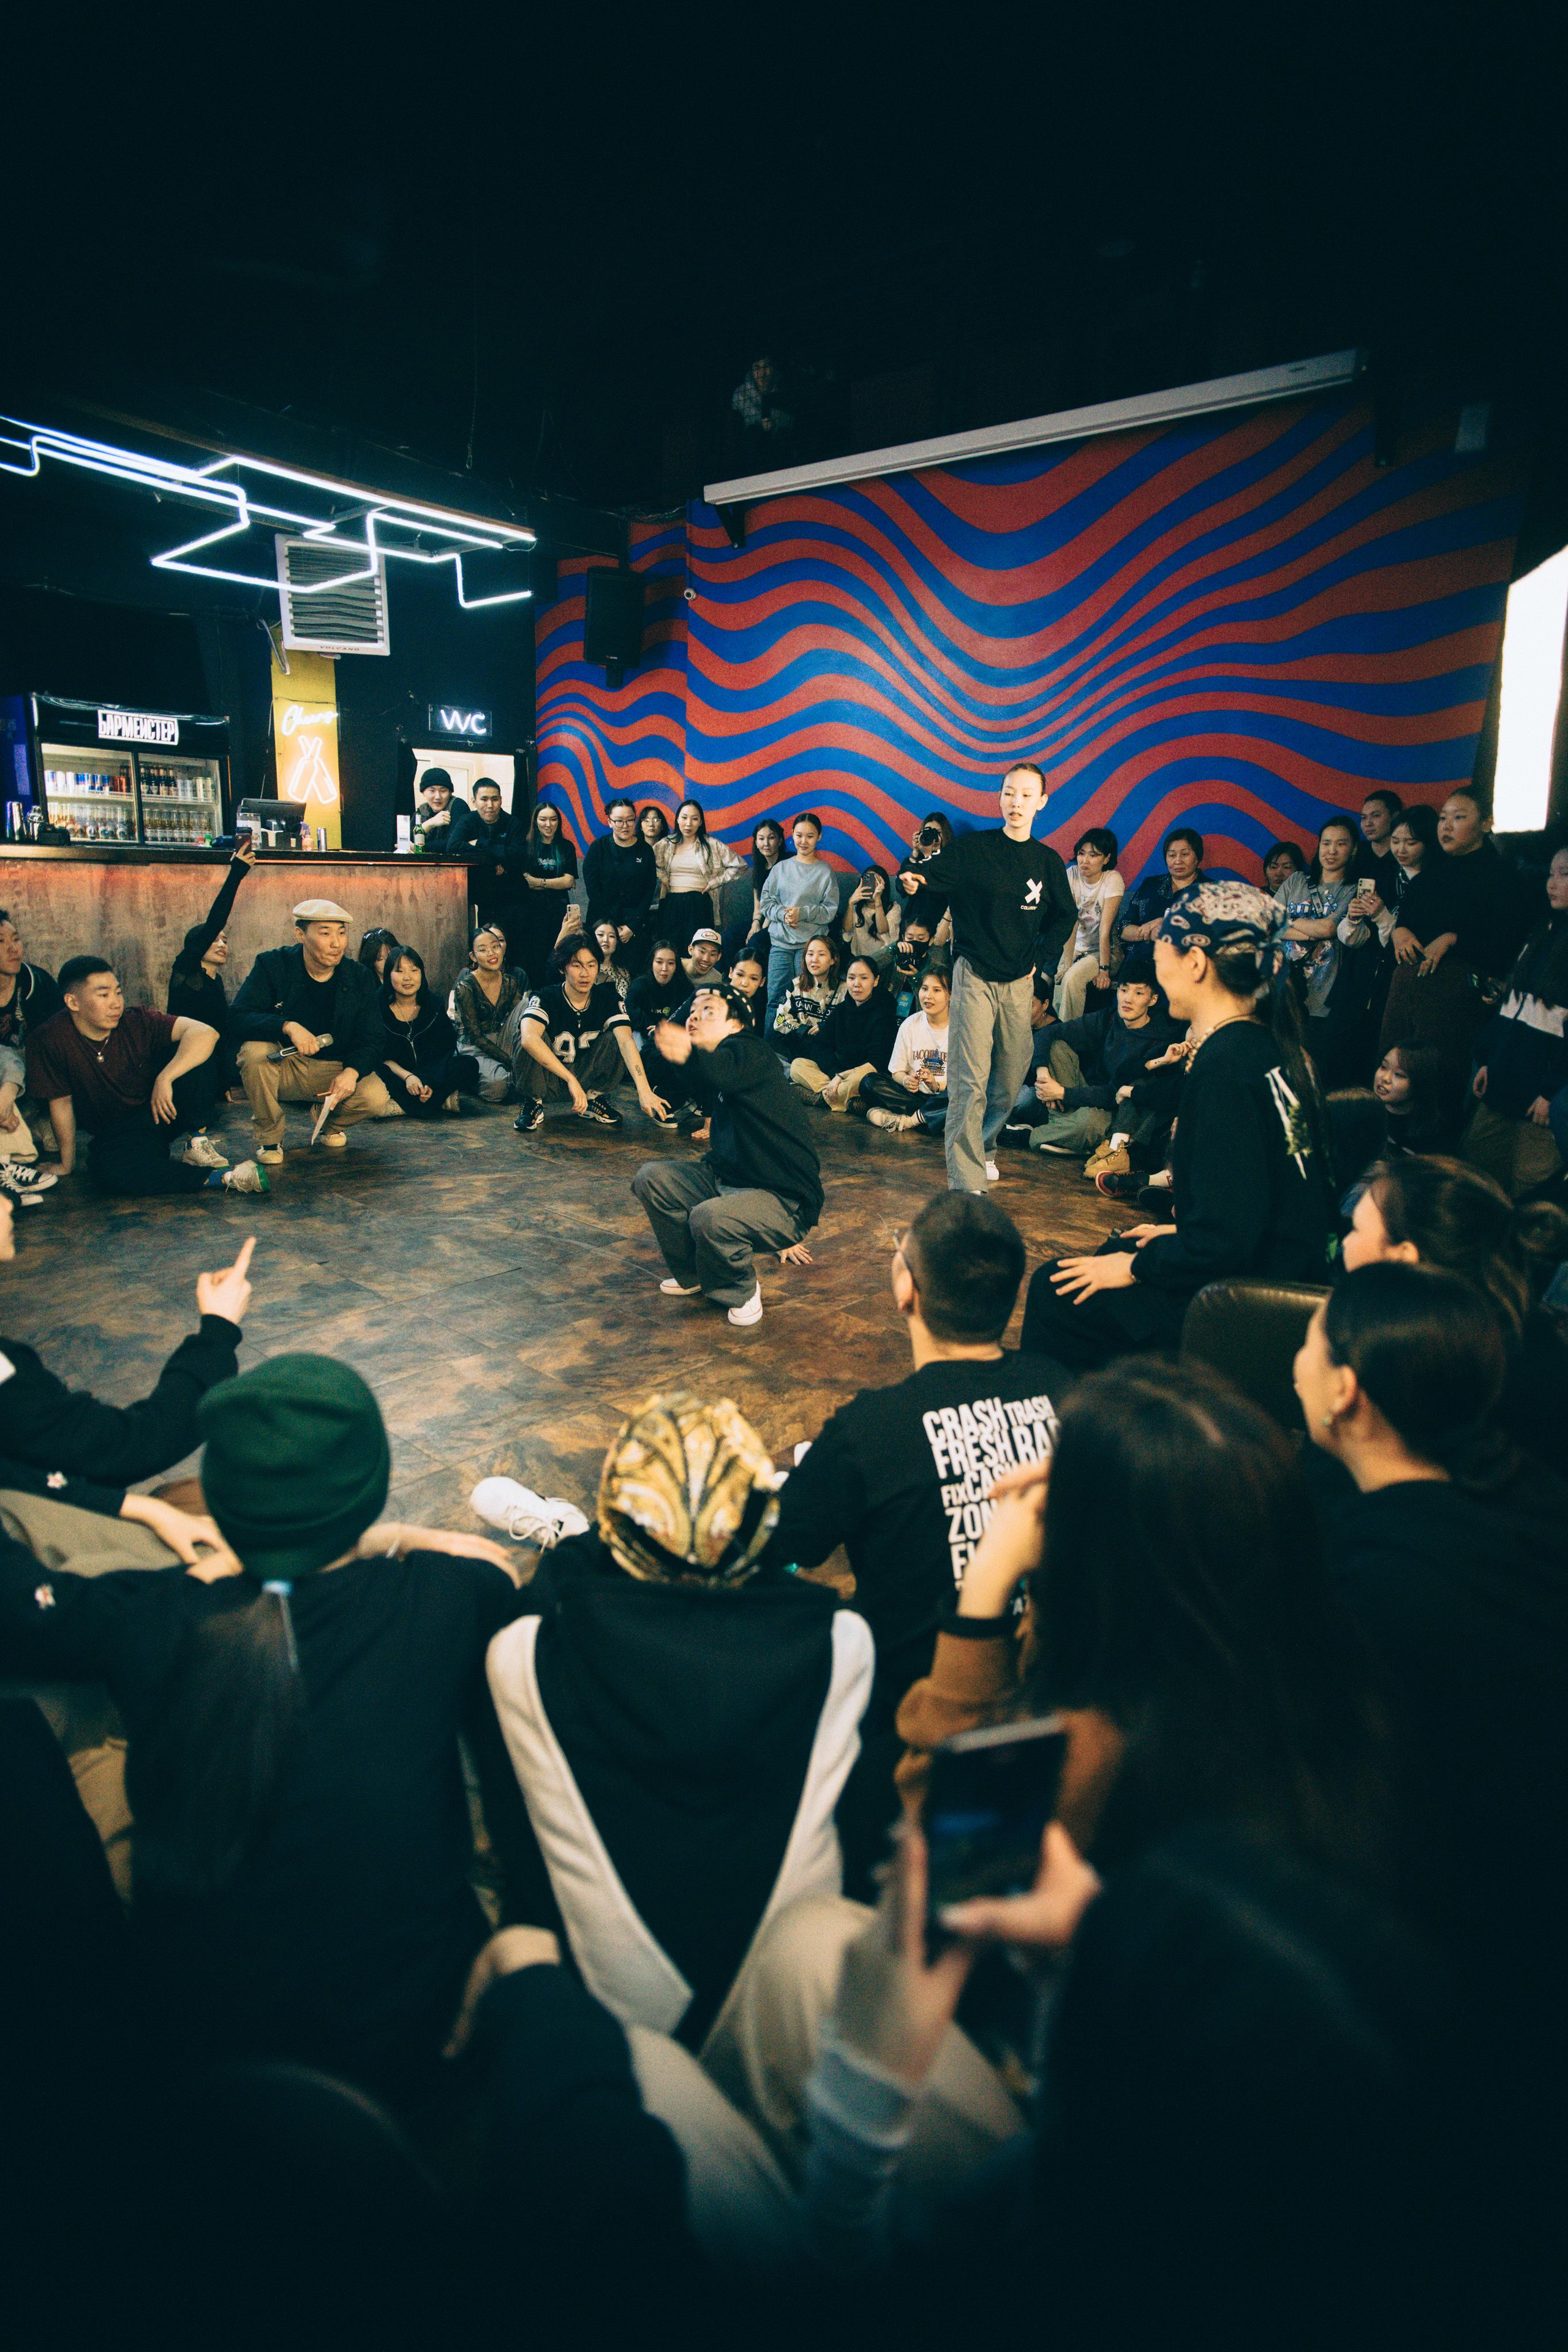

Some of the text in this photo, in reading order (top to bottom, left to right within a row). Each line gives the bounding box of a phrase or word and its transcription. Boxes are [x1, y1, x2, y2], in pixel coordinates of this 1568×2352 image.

[98, 709, 176, 742] БАРМЕЙСТЕР
[440, 709, 486, 734] WC
[922, 1396, 1009, 1444] CRASH
[931, 1429, 1016, 1480] FRESH
